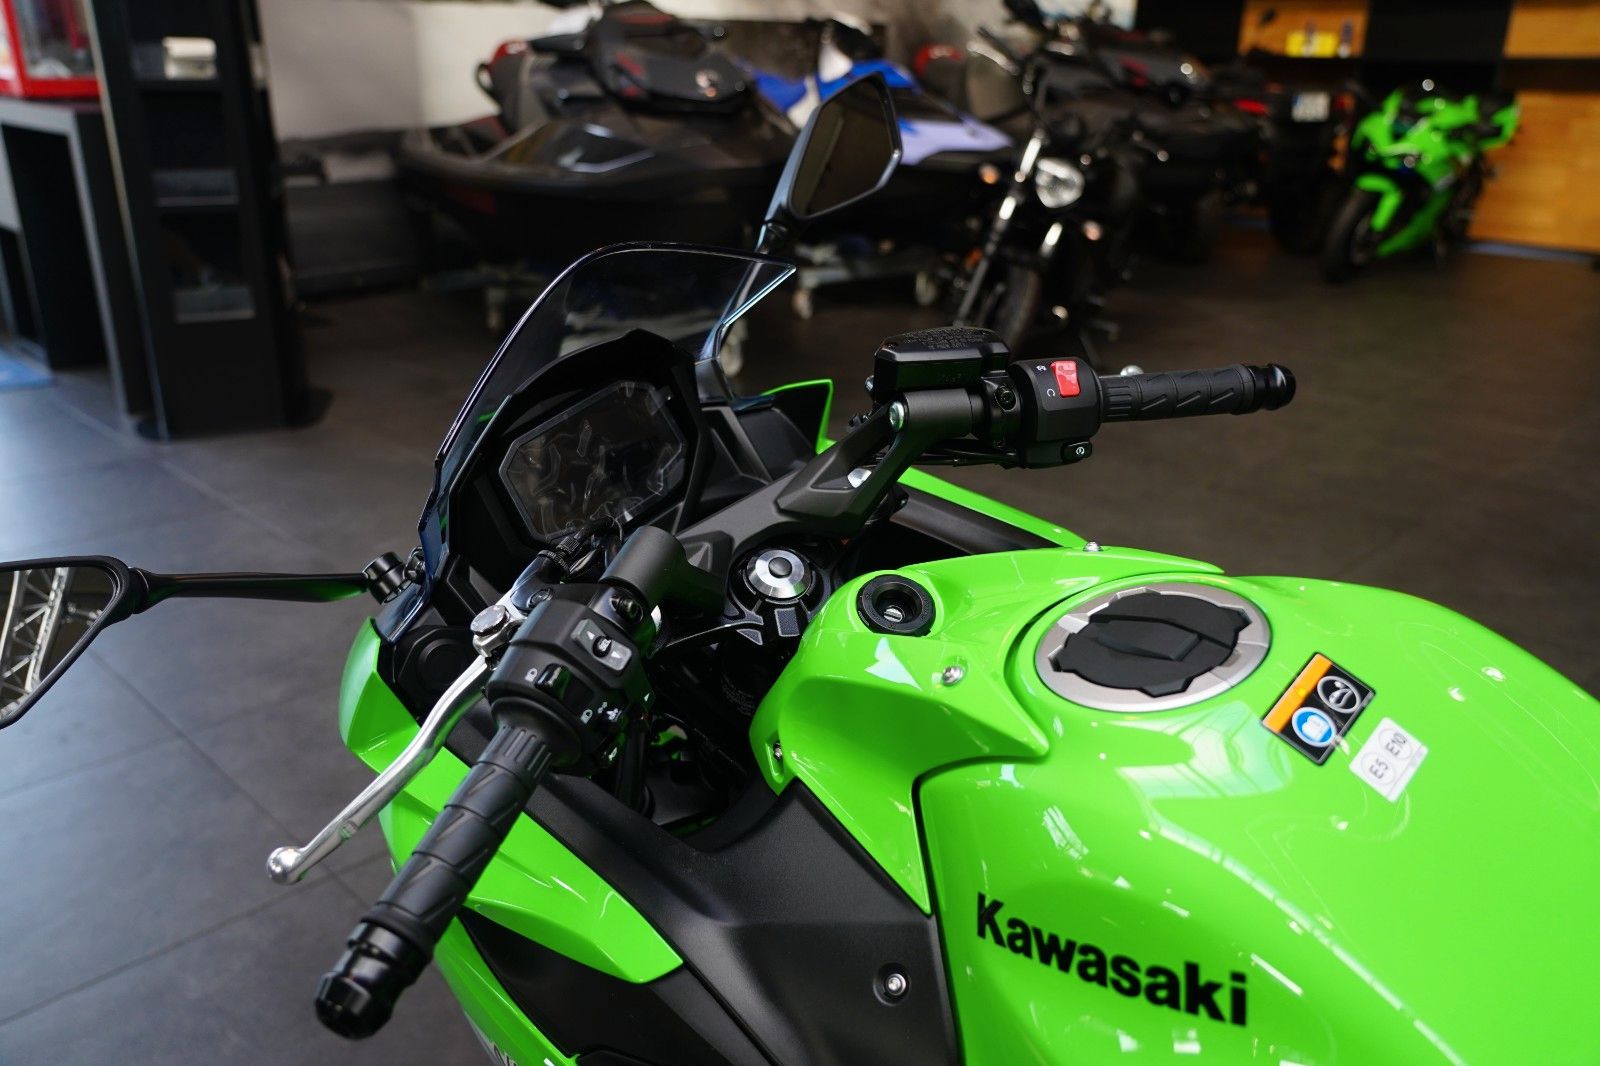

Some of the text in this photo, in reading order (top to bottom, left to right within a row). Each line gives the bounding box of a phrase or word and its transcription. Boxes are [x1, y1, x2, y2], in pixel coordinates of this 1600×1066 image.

[1369, 732, 1407, 779] E5 E10
[976, 892, 1248, 1026] Kawasaki
